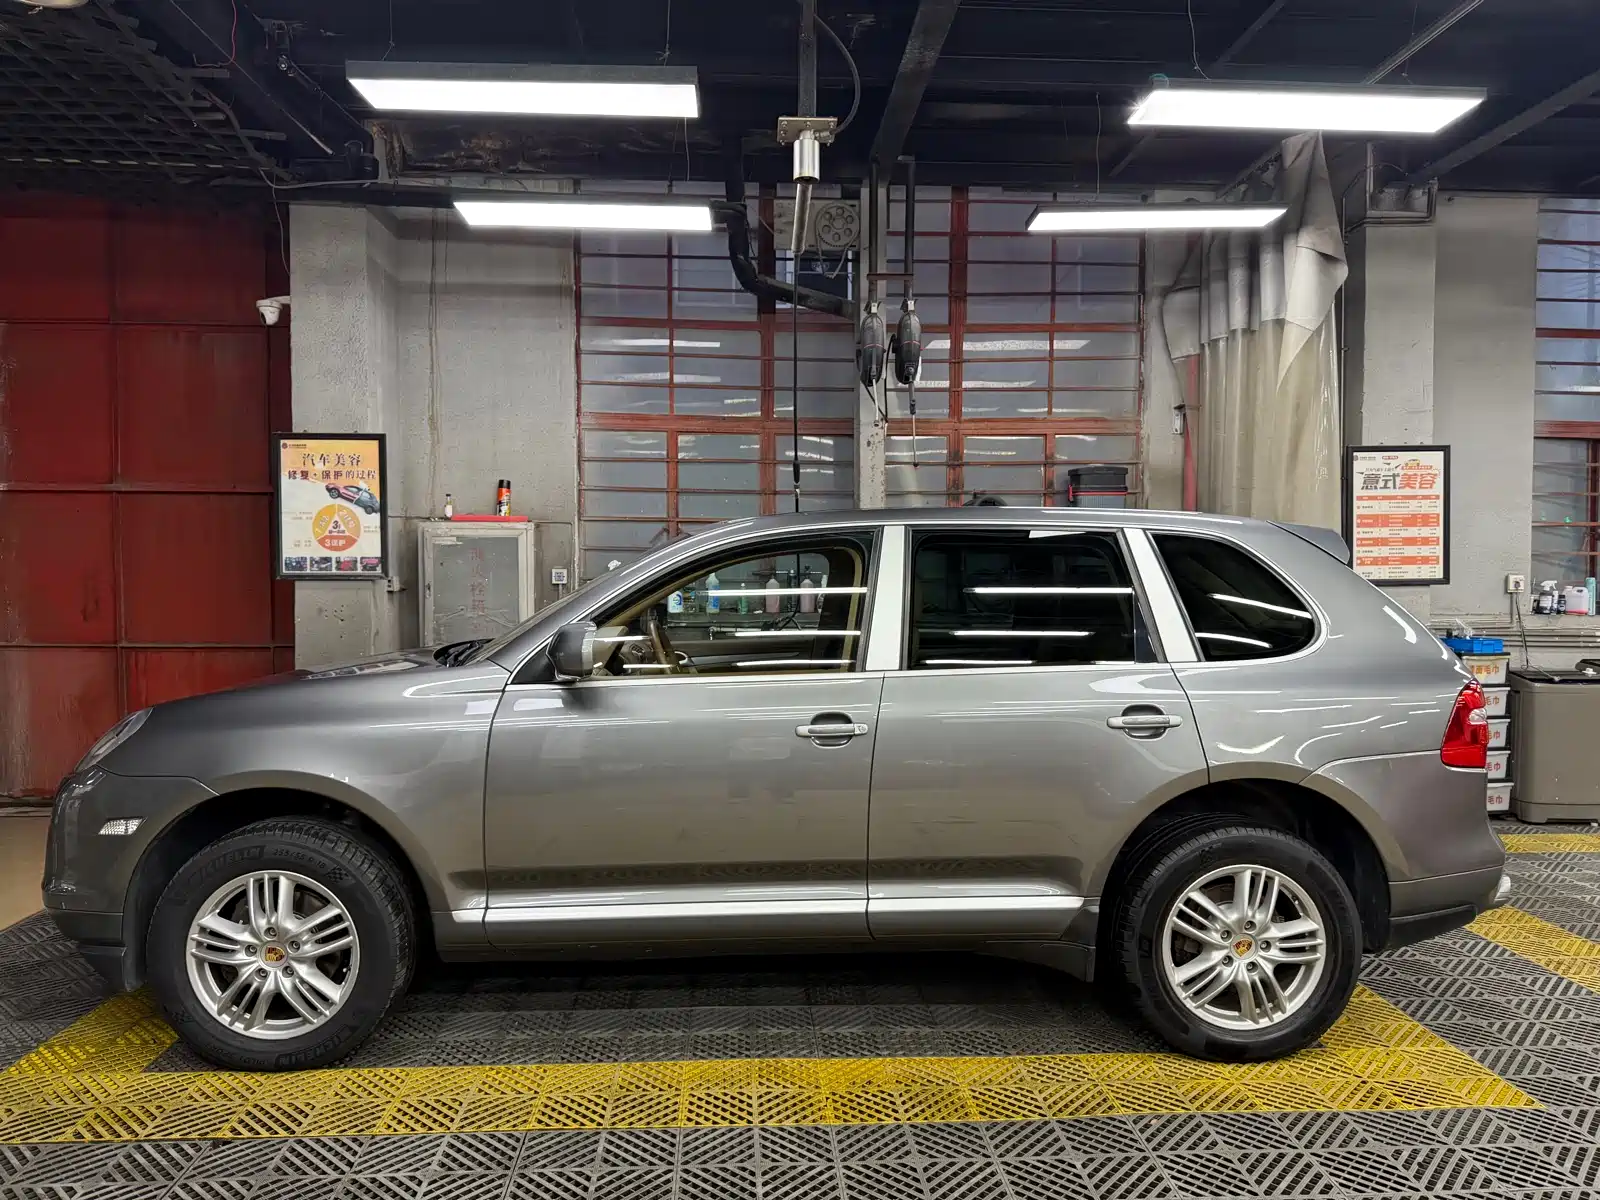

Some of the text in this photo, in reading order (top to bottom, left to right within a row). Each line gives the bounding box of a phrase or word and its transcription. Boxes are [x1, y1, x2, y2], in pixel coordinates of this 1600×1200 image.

[302, 453, 361, 466] 汽车美容
[1361, 473, 1438, 490] 意式美容
